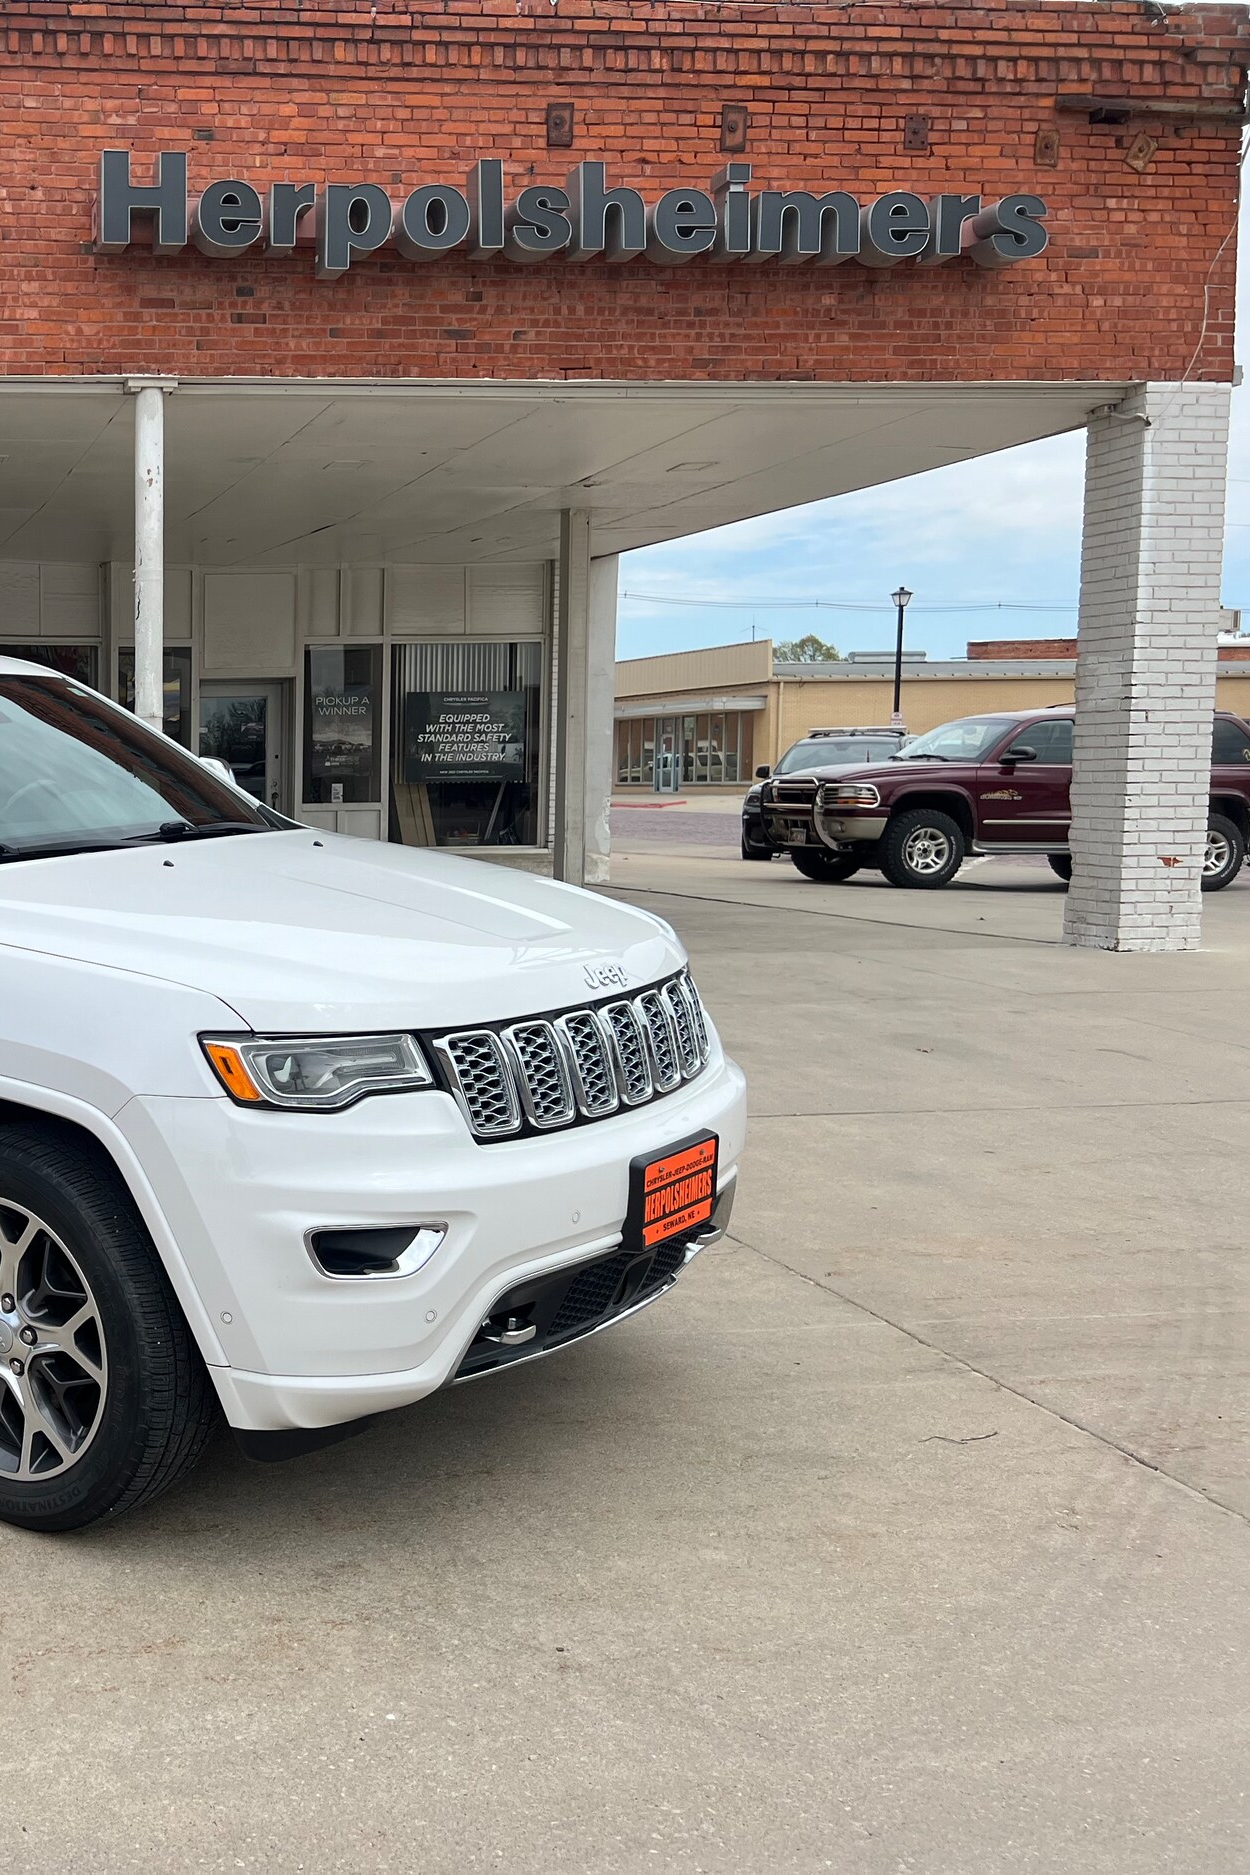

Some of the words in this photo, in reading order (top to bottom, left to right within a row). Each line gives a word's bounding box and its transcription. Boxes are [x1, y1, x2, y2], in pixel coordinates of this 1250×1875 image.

[96, 150, 1050, 277] Herpolsheimers
[315, 696, 359, 706] PICKUP
[361, 696, 370, 705] A
[318, 706, 367, 716] WINNER
[439, 714, 490, 723] EQUIPPED
[425, 724, 452, 733] WITH
[454, 724, 474, 733] THE
[475, 723, 505, 732] MOST
[417, 733, 471, 743] STANDARD
[473, 733, 512, 742] SAFETY
[438, 743, 490, 752] FEATURES
[421, 753, 432, 762] IN
[434, 753, 454, 762] THE
[455, 753, 506, 762] INDUSTRY.
[582, 962, 629, 990] Jeep
[644, 1168, 713, 1224] HERPOLSHEIMERS
[662, 1214, 687, 1232] SEWARD,
[687, 1210, 696, 1221] NE
